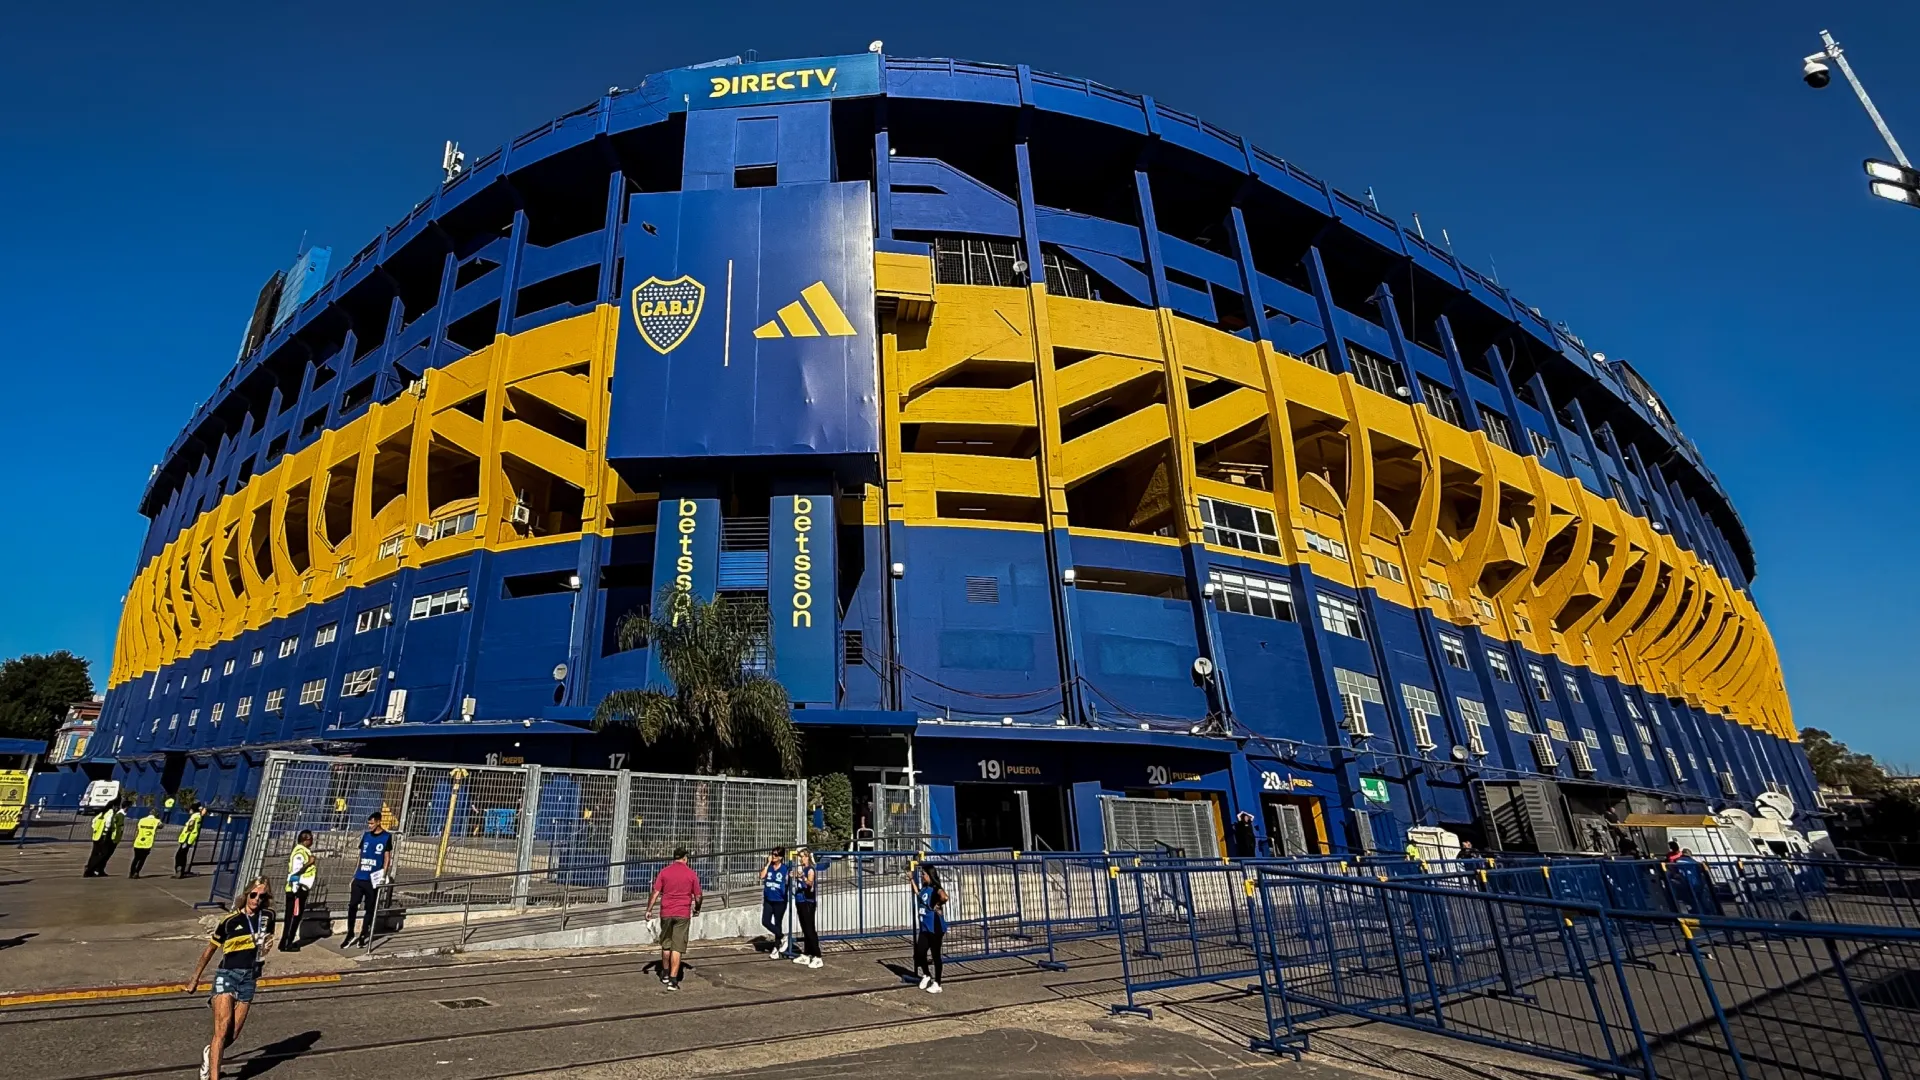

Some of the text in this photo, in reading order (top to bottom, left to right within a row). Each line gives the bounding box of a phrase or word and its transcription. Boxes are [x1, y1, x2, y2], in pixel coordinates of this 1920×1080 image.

[709, 67, 837, 98] DIRECTV
[640, 299, 695, 317] CABJ
[672, 497, 697, 628] betsson
[792, 494, 813, 628] betsson
[485, 752, 524, 766] 16 PUERTA
[608, 753, 626, 769] 17
[977, 759, 1041, 780] 19 PUERTA
[1146, 765, 1201, 785] 20 PUERTA
